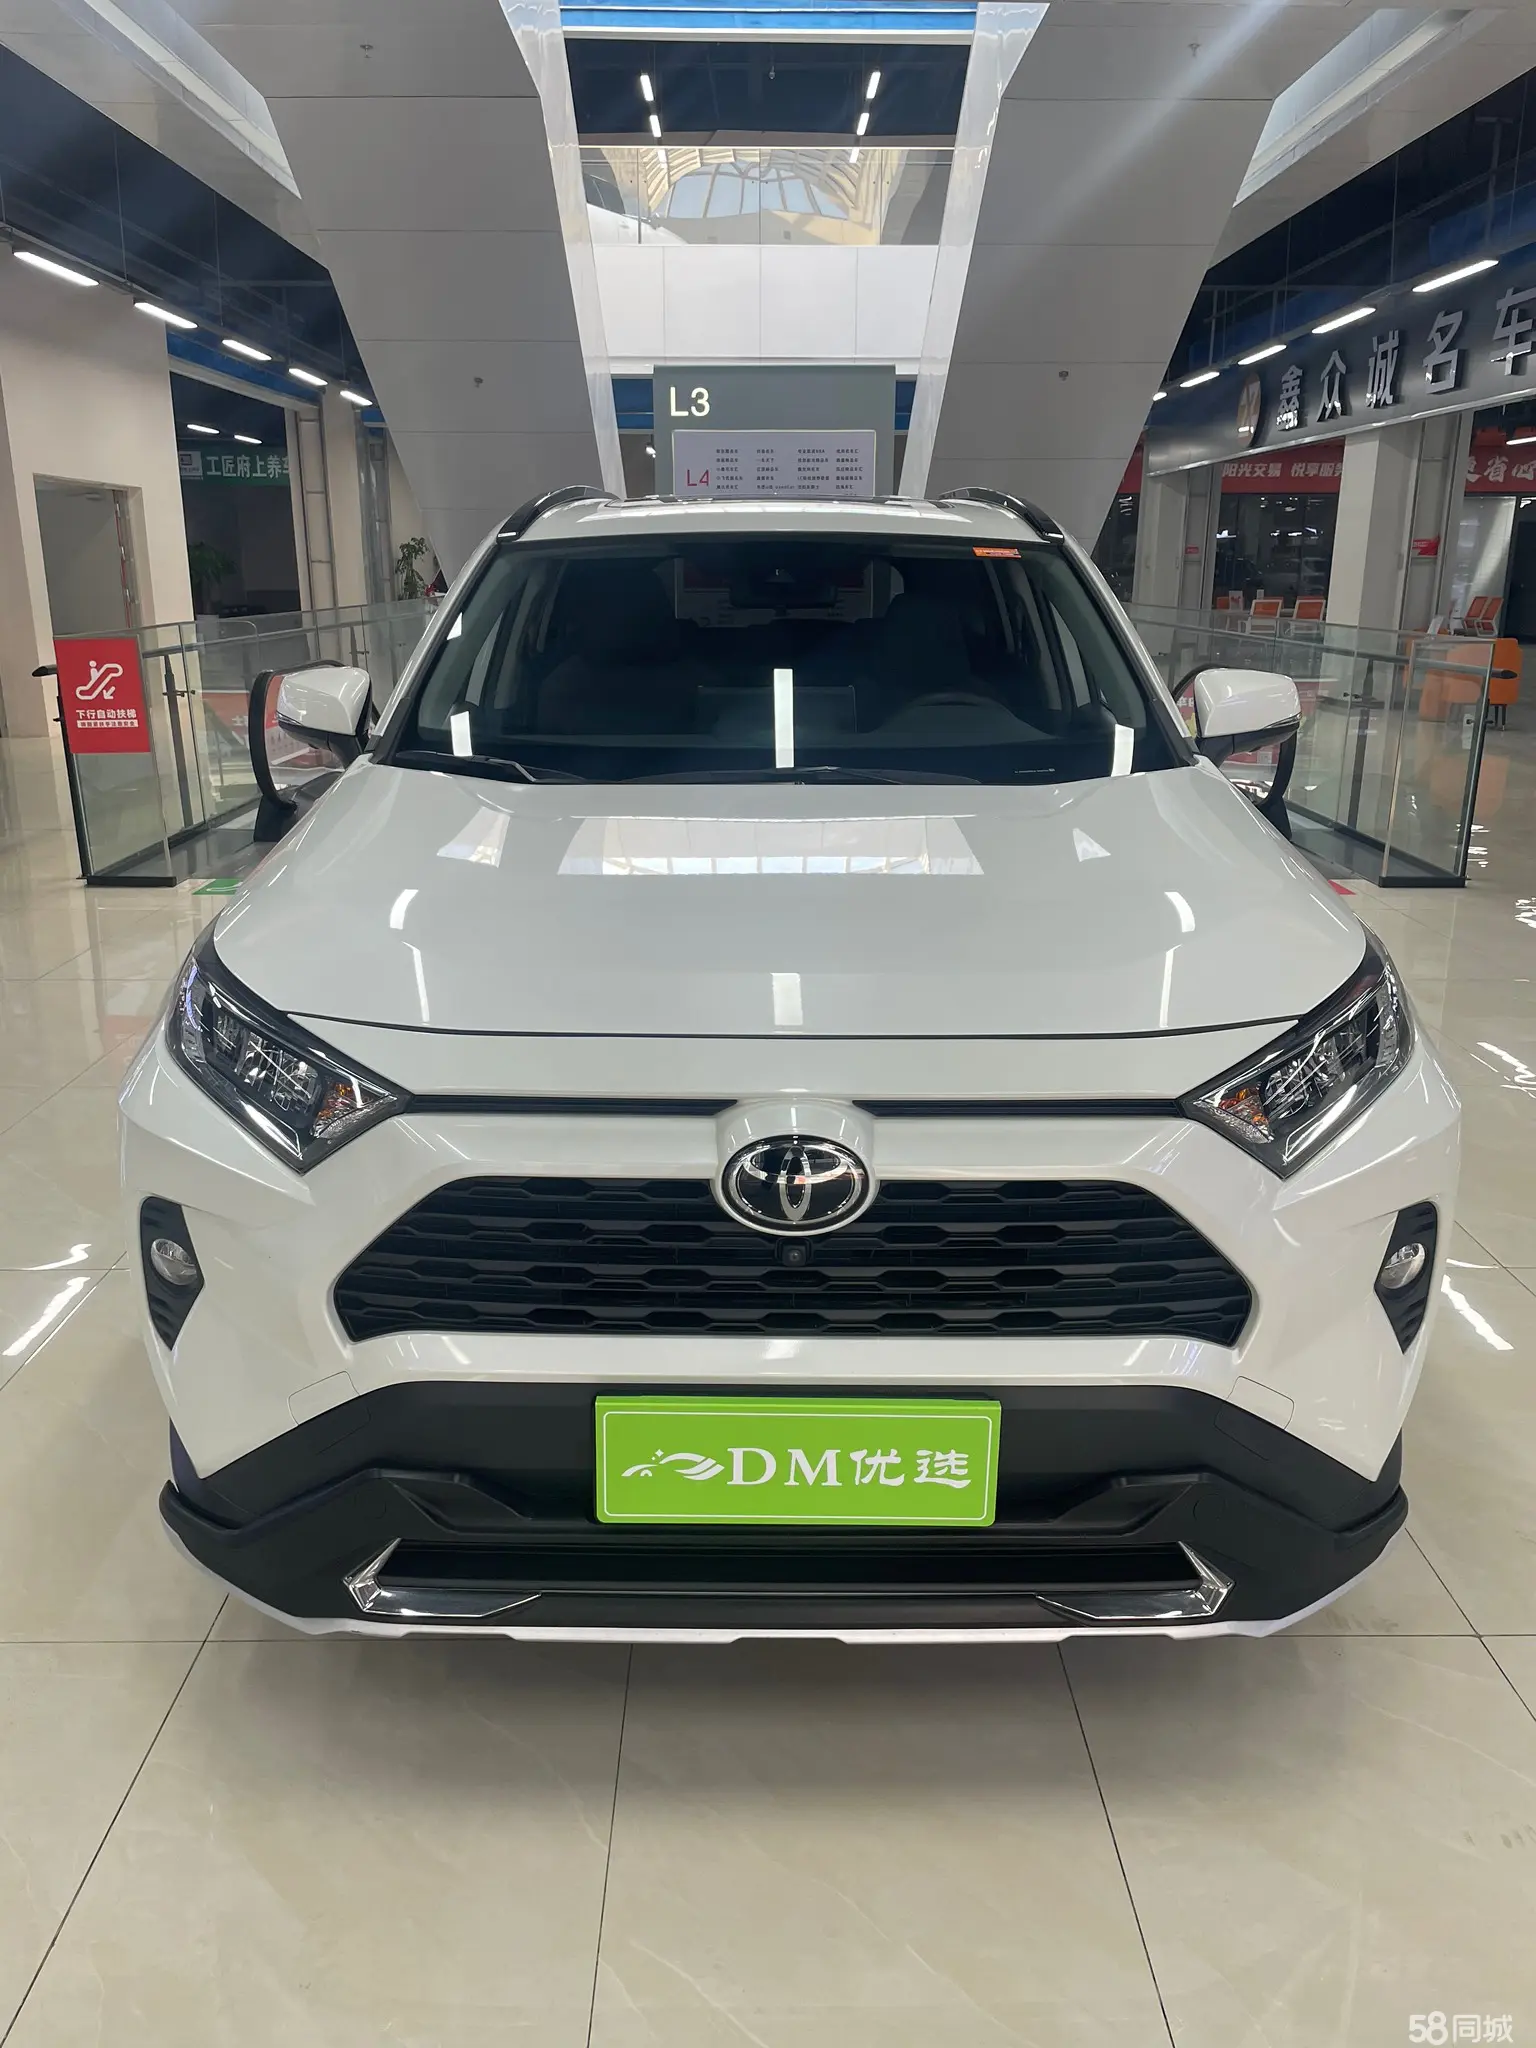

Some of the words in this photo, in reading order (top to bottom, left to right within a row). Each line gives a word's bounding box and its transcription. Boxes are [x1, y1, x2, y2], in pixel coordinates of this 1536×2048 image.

[1276, 286, 1536, 431] 鑫众诚名车
[670, 386, 710, 417] L3
[686, 469, 710, 487] L4
[1222, 462, 1283, 477] 阳光交易
[76, 708, 137, 720] 下行自动扶梯
[727, 1447, 972, 1489] DM优选
